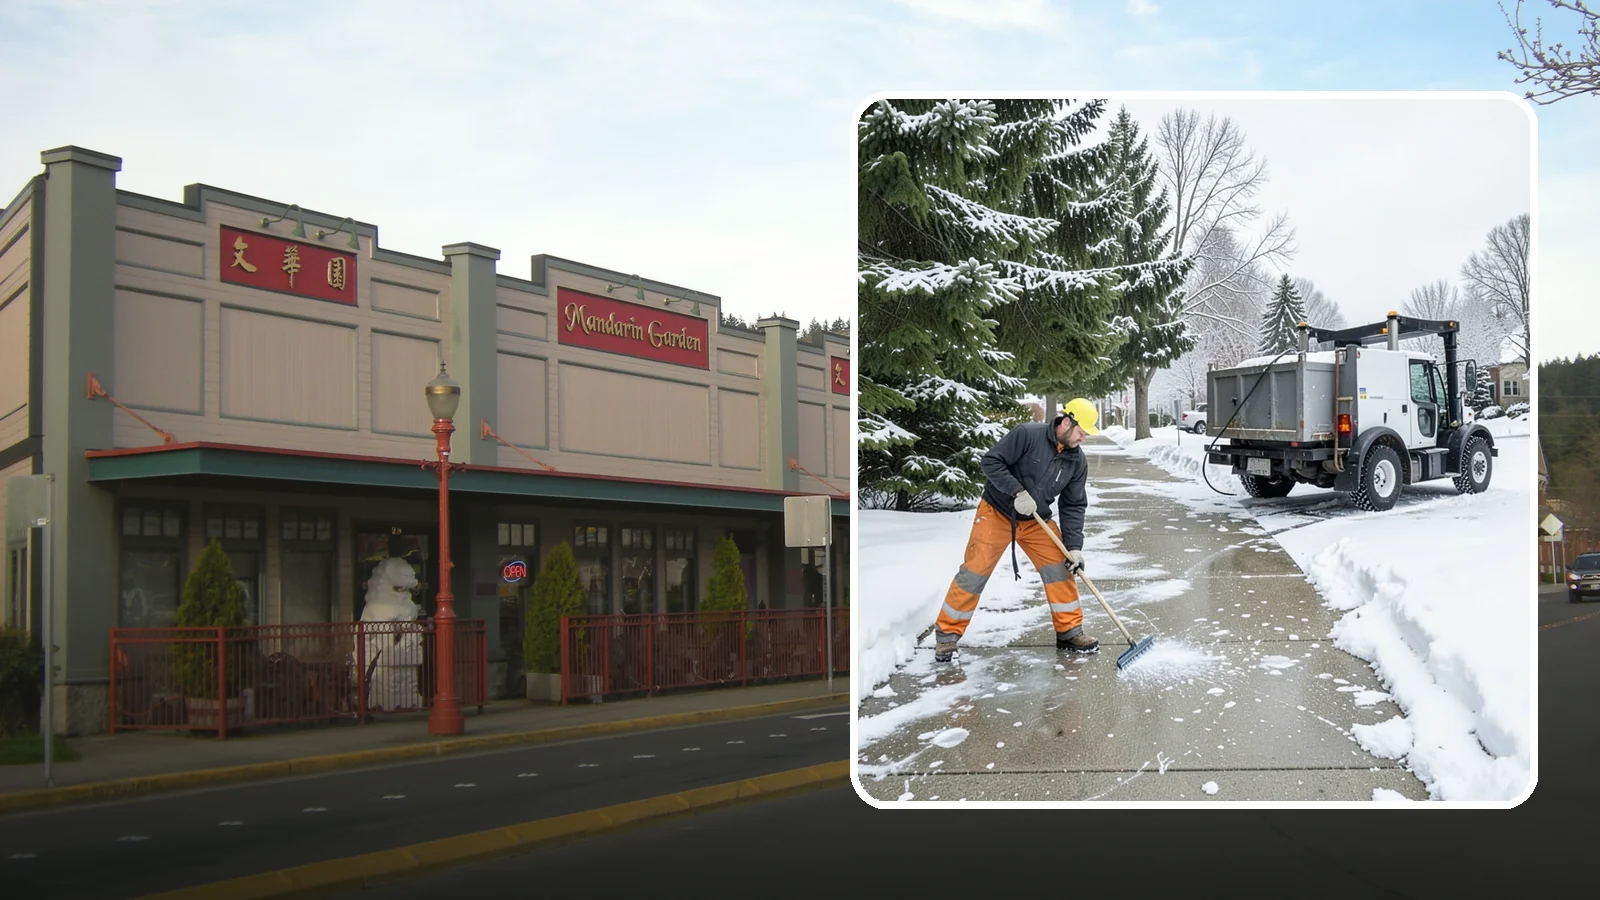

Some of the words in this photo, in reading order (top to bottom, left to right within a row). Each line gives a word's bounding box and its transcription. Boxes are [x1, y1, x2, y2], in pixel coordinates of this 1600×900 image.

[230, 236, 346, 290] 文華園
[564, 302, 644, 341] Mandarin
[648, 320, 701, 352] Garden
[503, 565, 527, 578] OPEN
